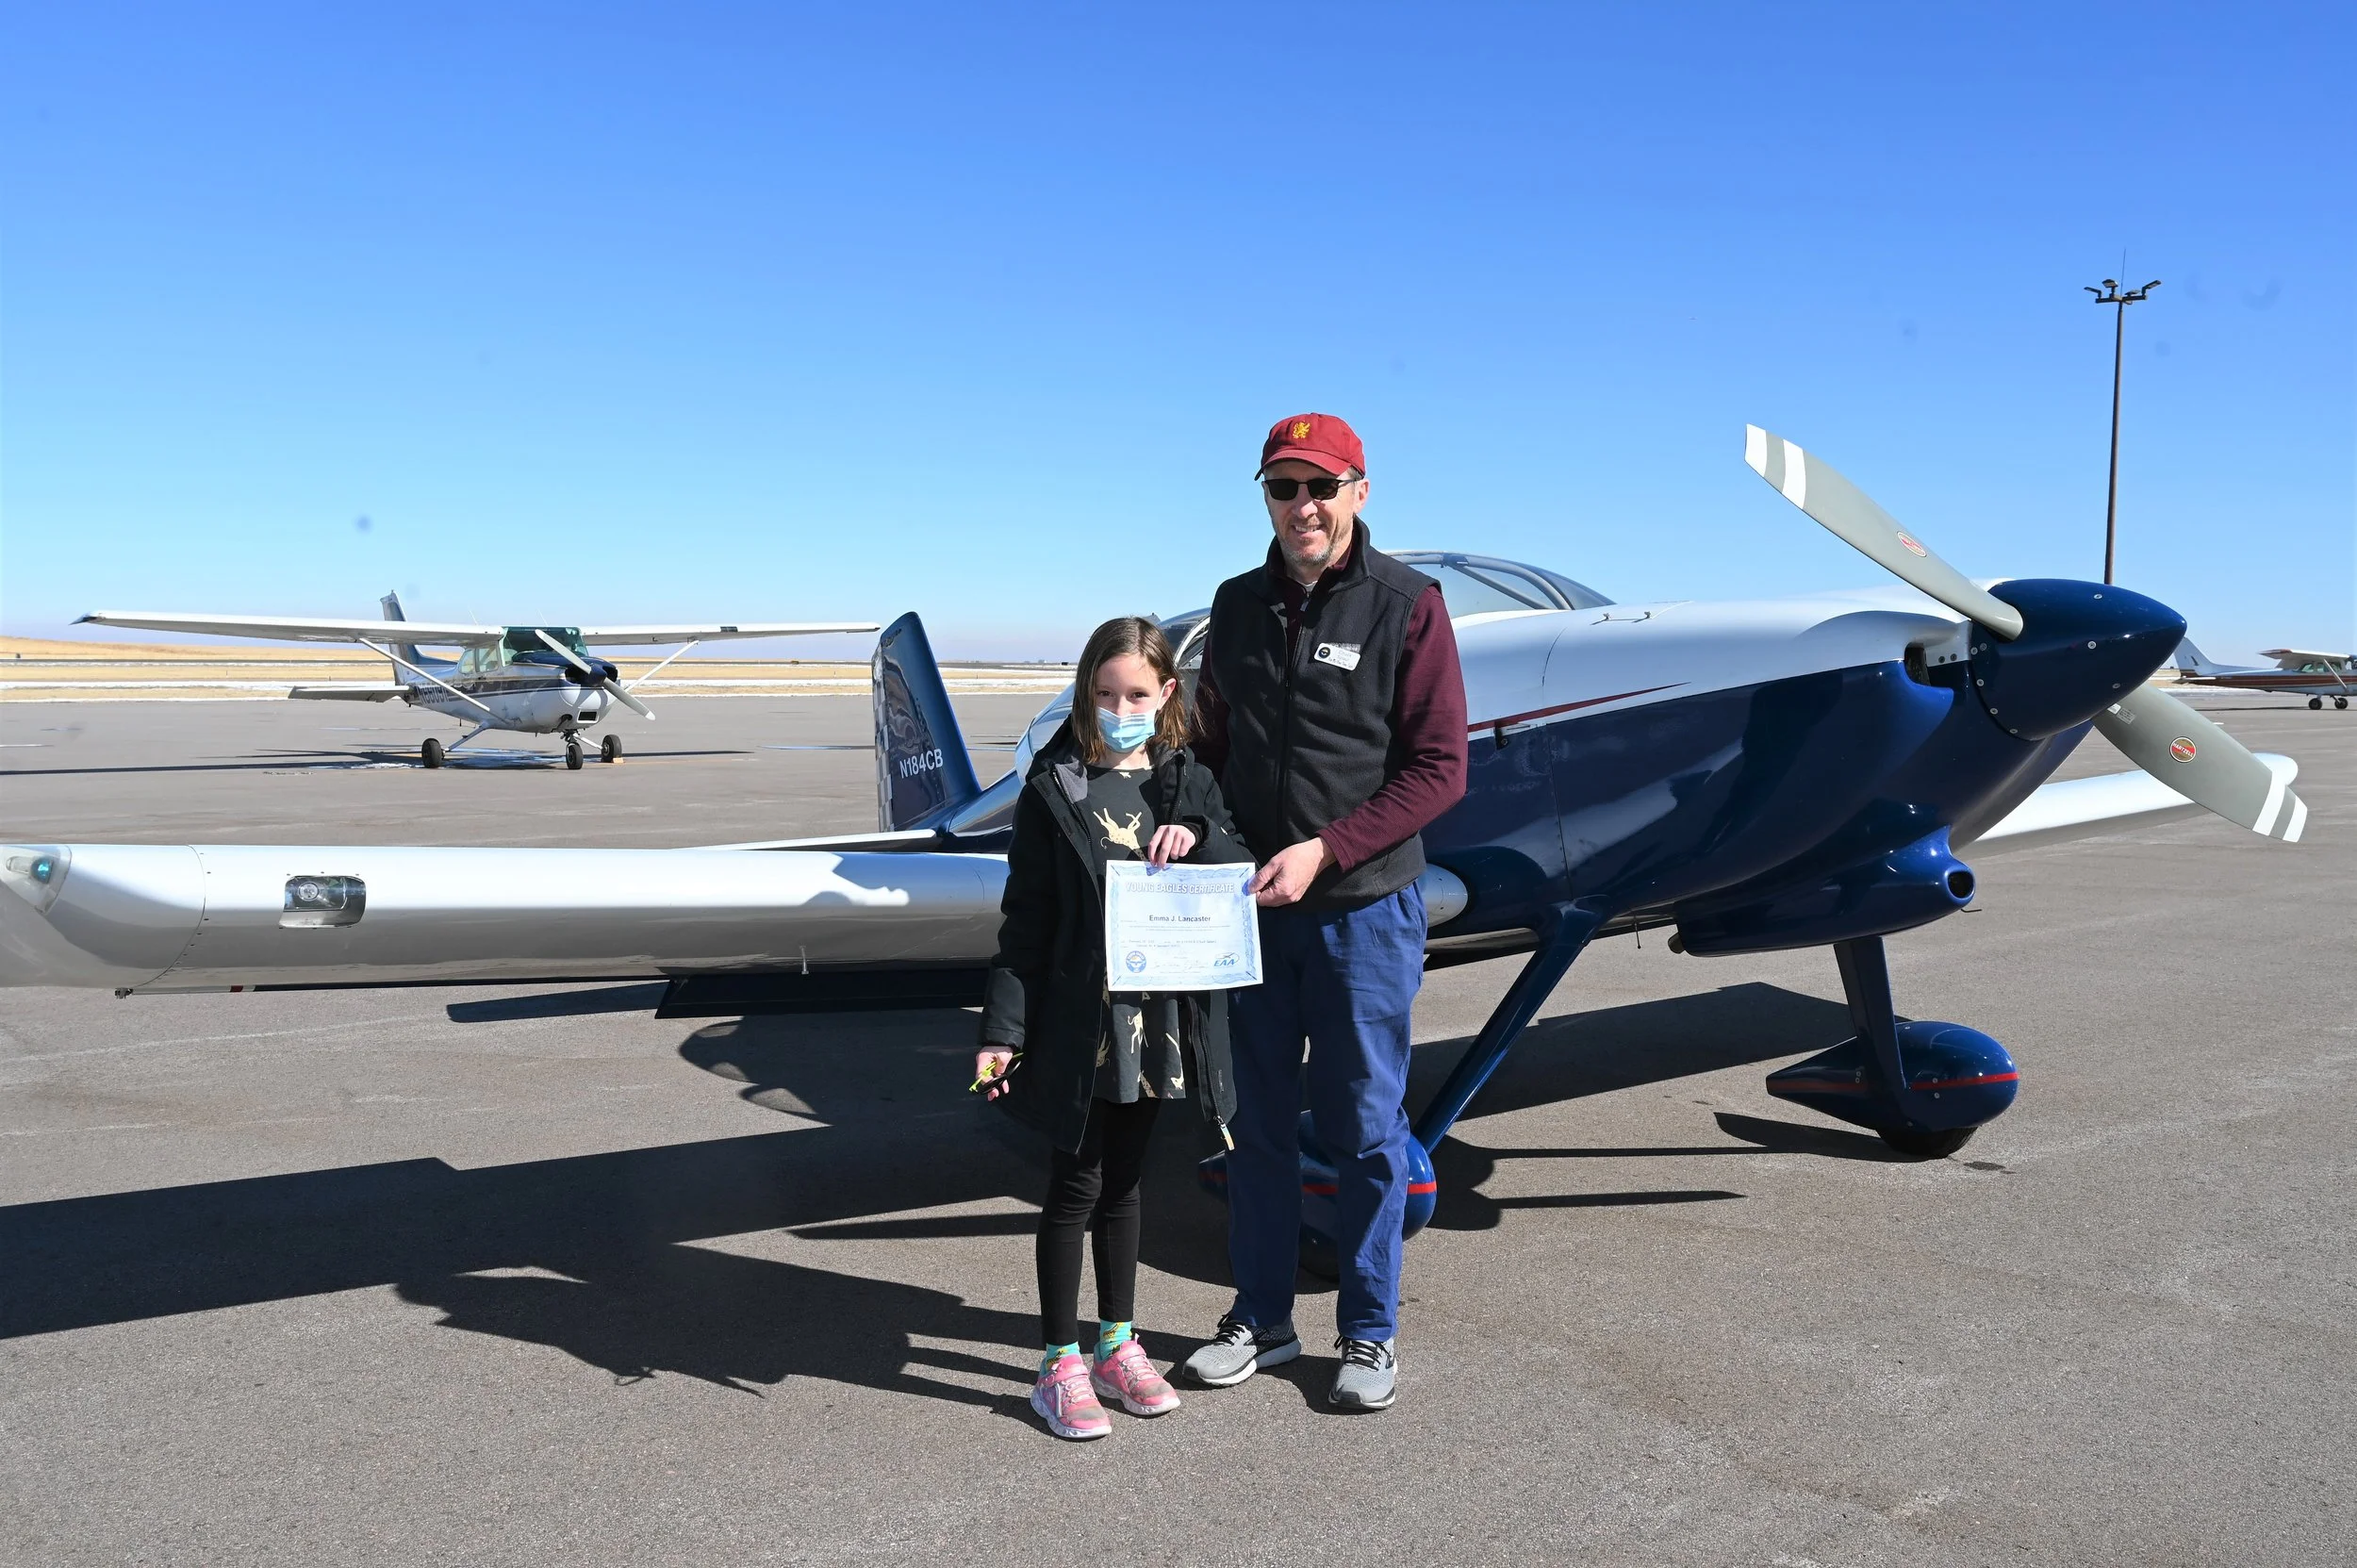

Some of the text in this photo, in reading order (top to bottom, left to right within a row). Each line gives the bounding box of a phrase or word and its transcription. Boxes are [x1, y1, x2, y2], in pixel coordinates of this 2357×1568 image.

[899, 749, 944, 779] N184CB
[1126, 882, 1155, 892] YOUNG
[1156, 883, 1188, 894] EAGLES
